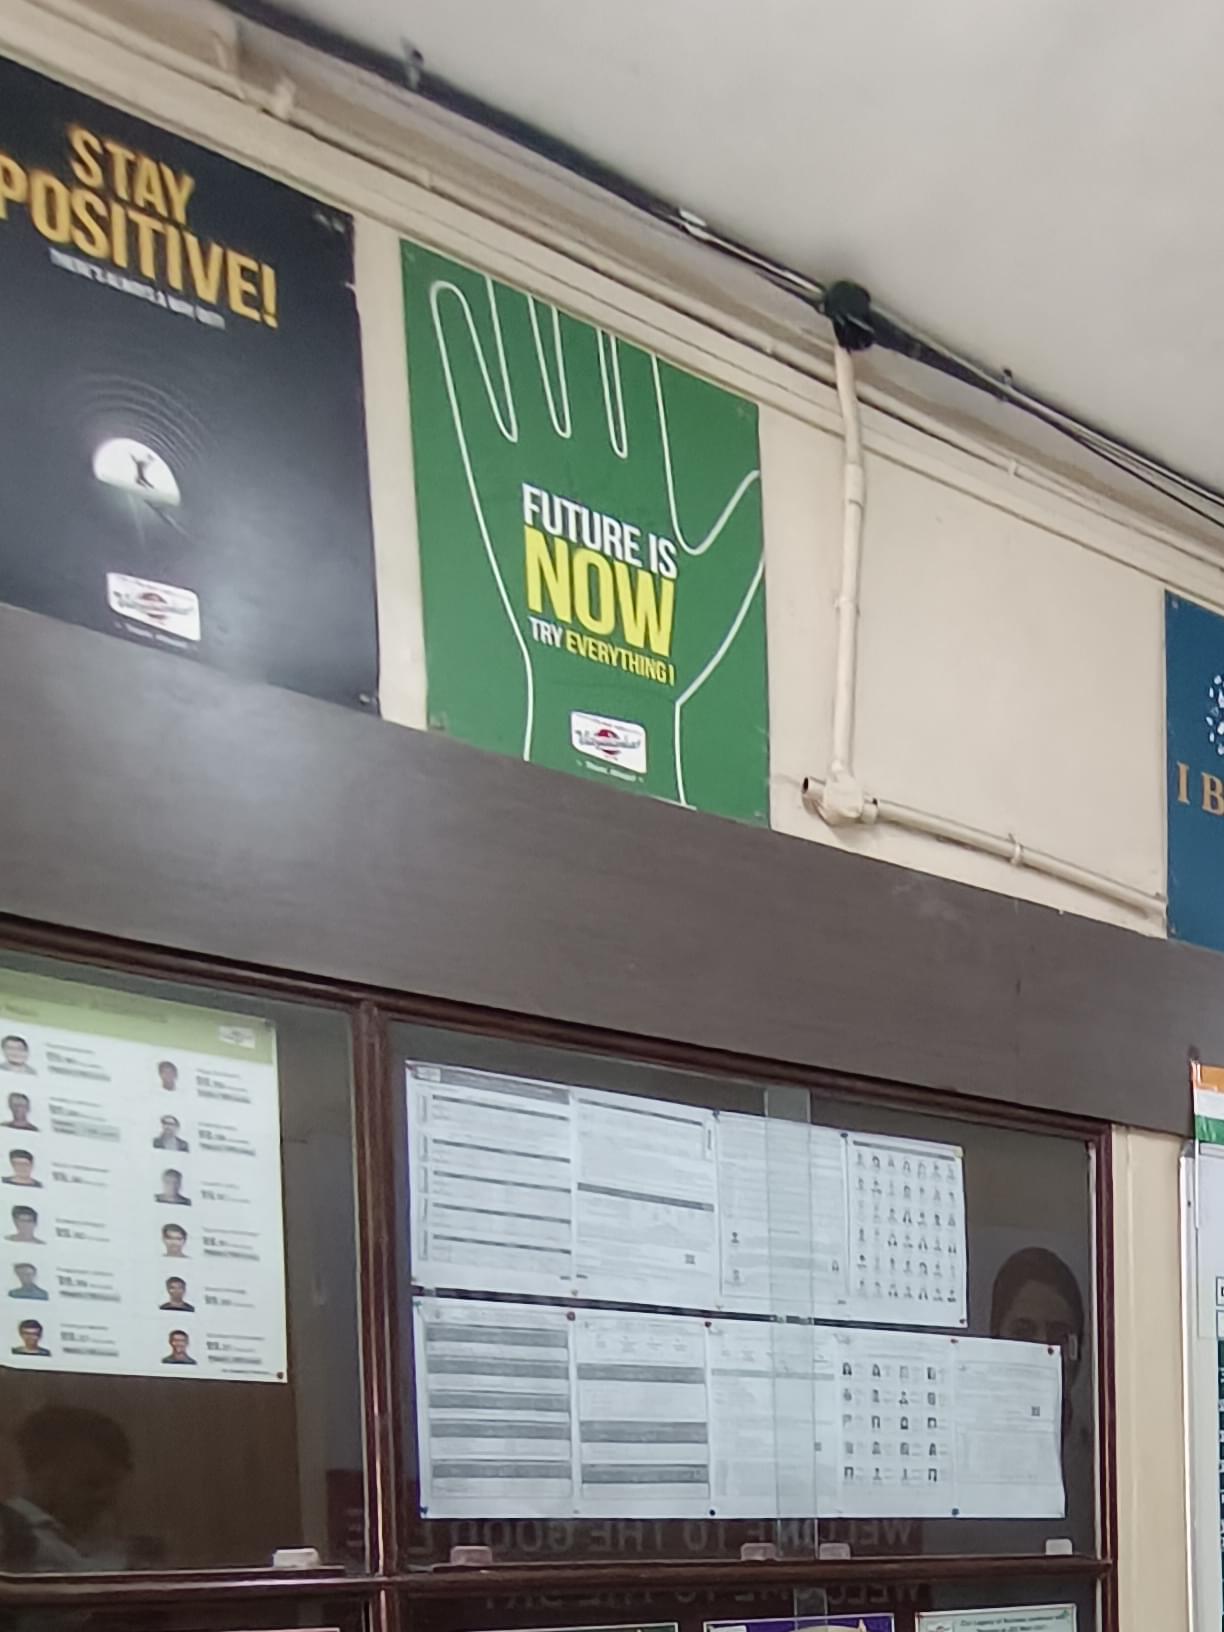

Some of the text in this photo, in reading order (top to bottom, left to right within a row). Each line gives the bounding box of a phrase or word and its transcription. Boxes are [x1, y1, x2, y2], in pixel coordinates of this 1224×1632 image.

[67, 124, 196, 226] STAY
[0, 154, 279, 330] POSITIVE!
[522, 482, 679, 580] FUTURE IS
[523, 526, 677, 657] NOW
[527, 616, 676, 688] TRY EVERYTHING!
[1176, 761, 1191, 806] I
